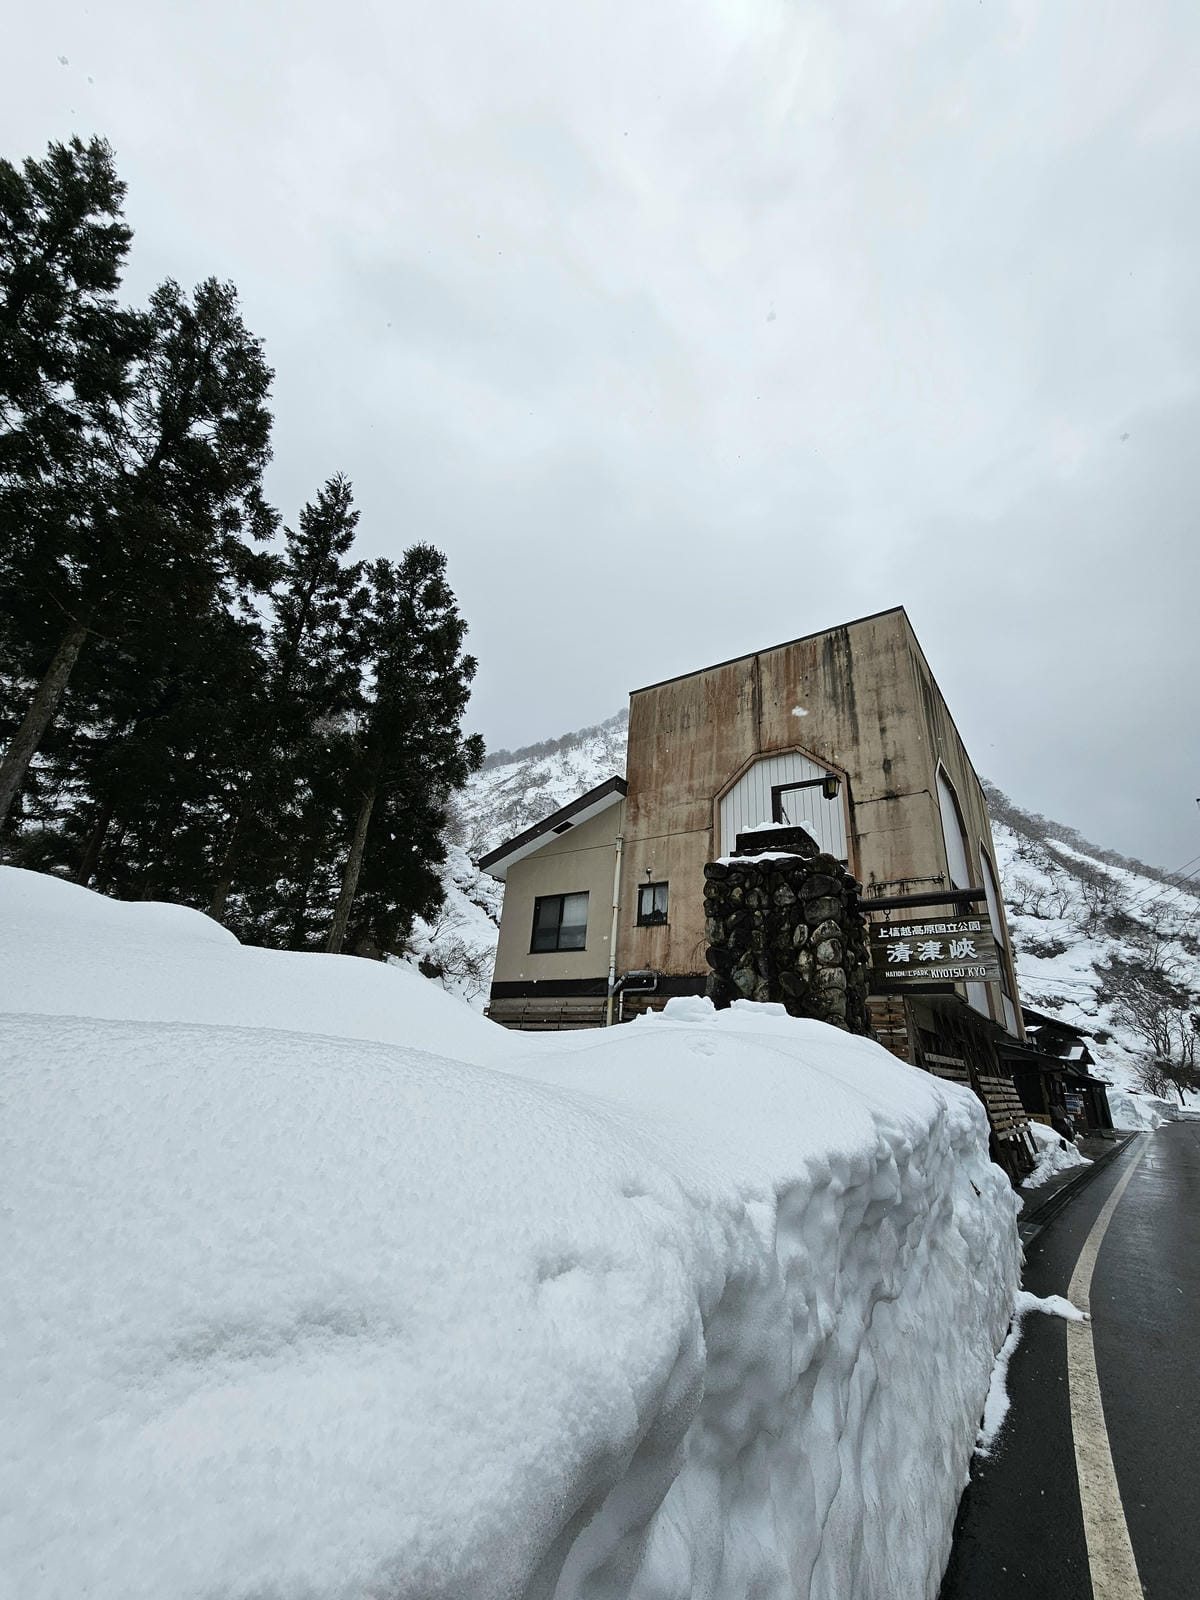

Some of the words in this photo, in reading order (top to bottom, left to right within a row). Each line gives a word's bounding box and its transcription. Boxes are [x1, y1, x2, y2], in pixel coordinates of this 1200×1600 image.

[885, 970, 913, 978] NATIONL
[931, 968, 965, 978] KIYOTSU
[968, 967, 986, 977] KYO
